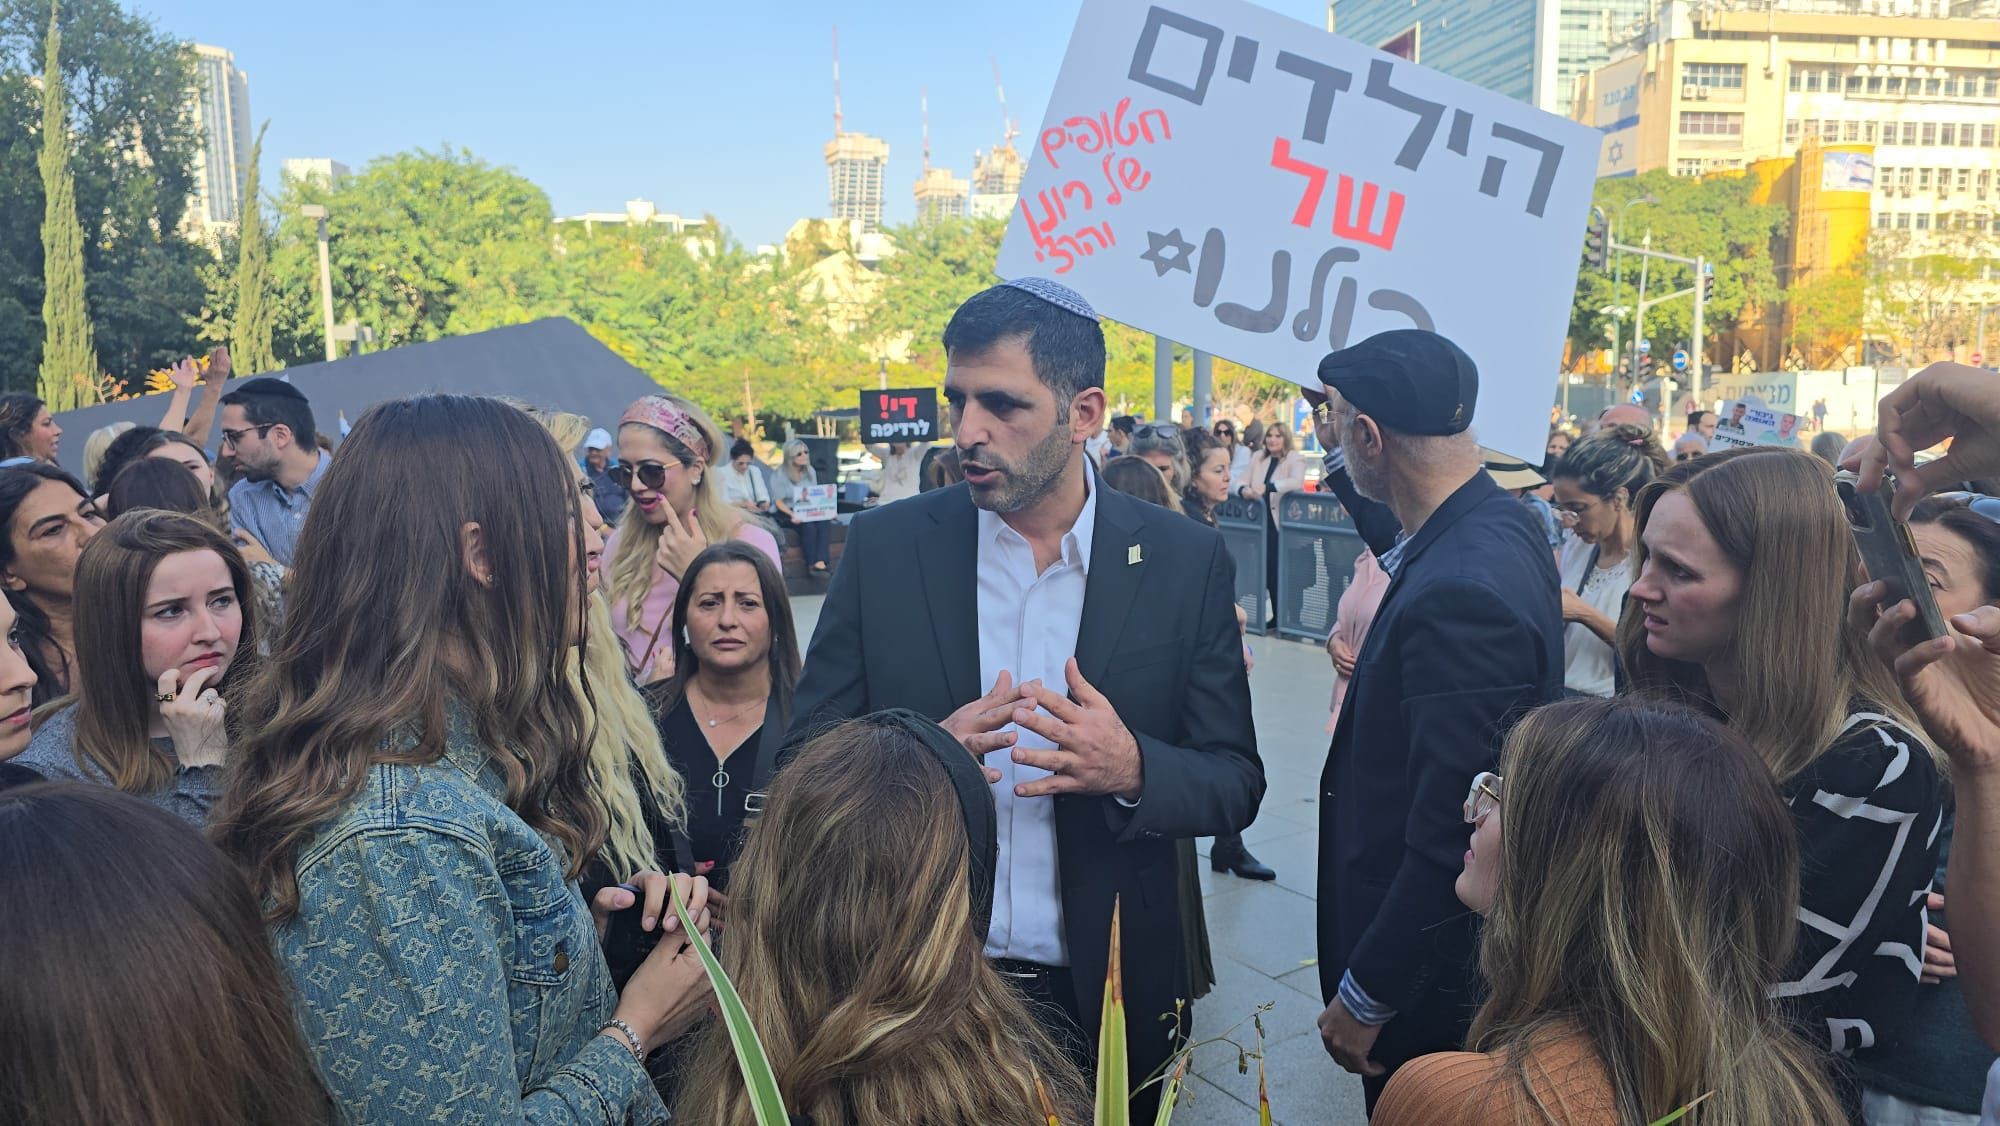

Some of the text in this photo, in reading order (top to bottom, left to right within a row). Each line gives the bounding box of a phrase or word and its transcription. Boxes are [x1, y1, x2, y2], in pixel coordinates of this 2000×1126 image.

[1041, 96, 1171, 169] חטופים
[1127, 5, 1565, 218] הילדים
[1020, 151, 1151, 249] של רונן
[1271, 137, 1405, 251] של
[870, 418, 930, 438] לרדיפה
[880, 394, 918, 419] די!
